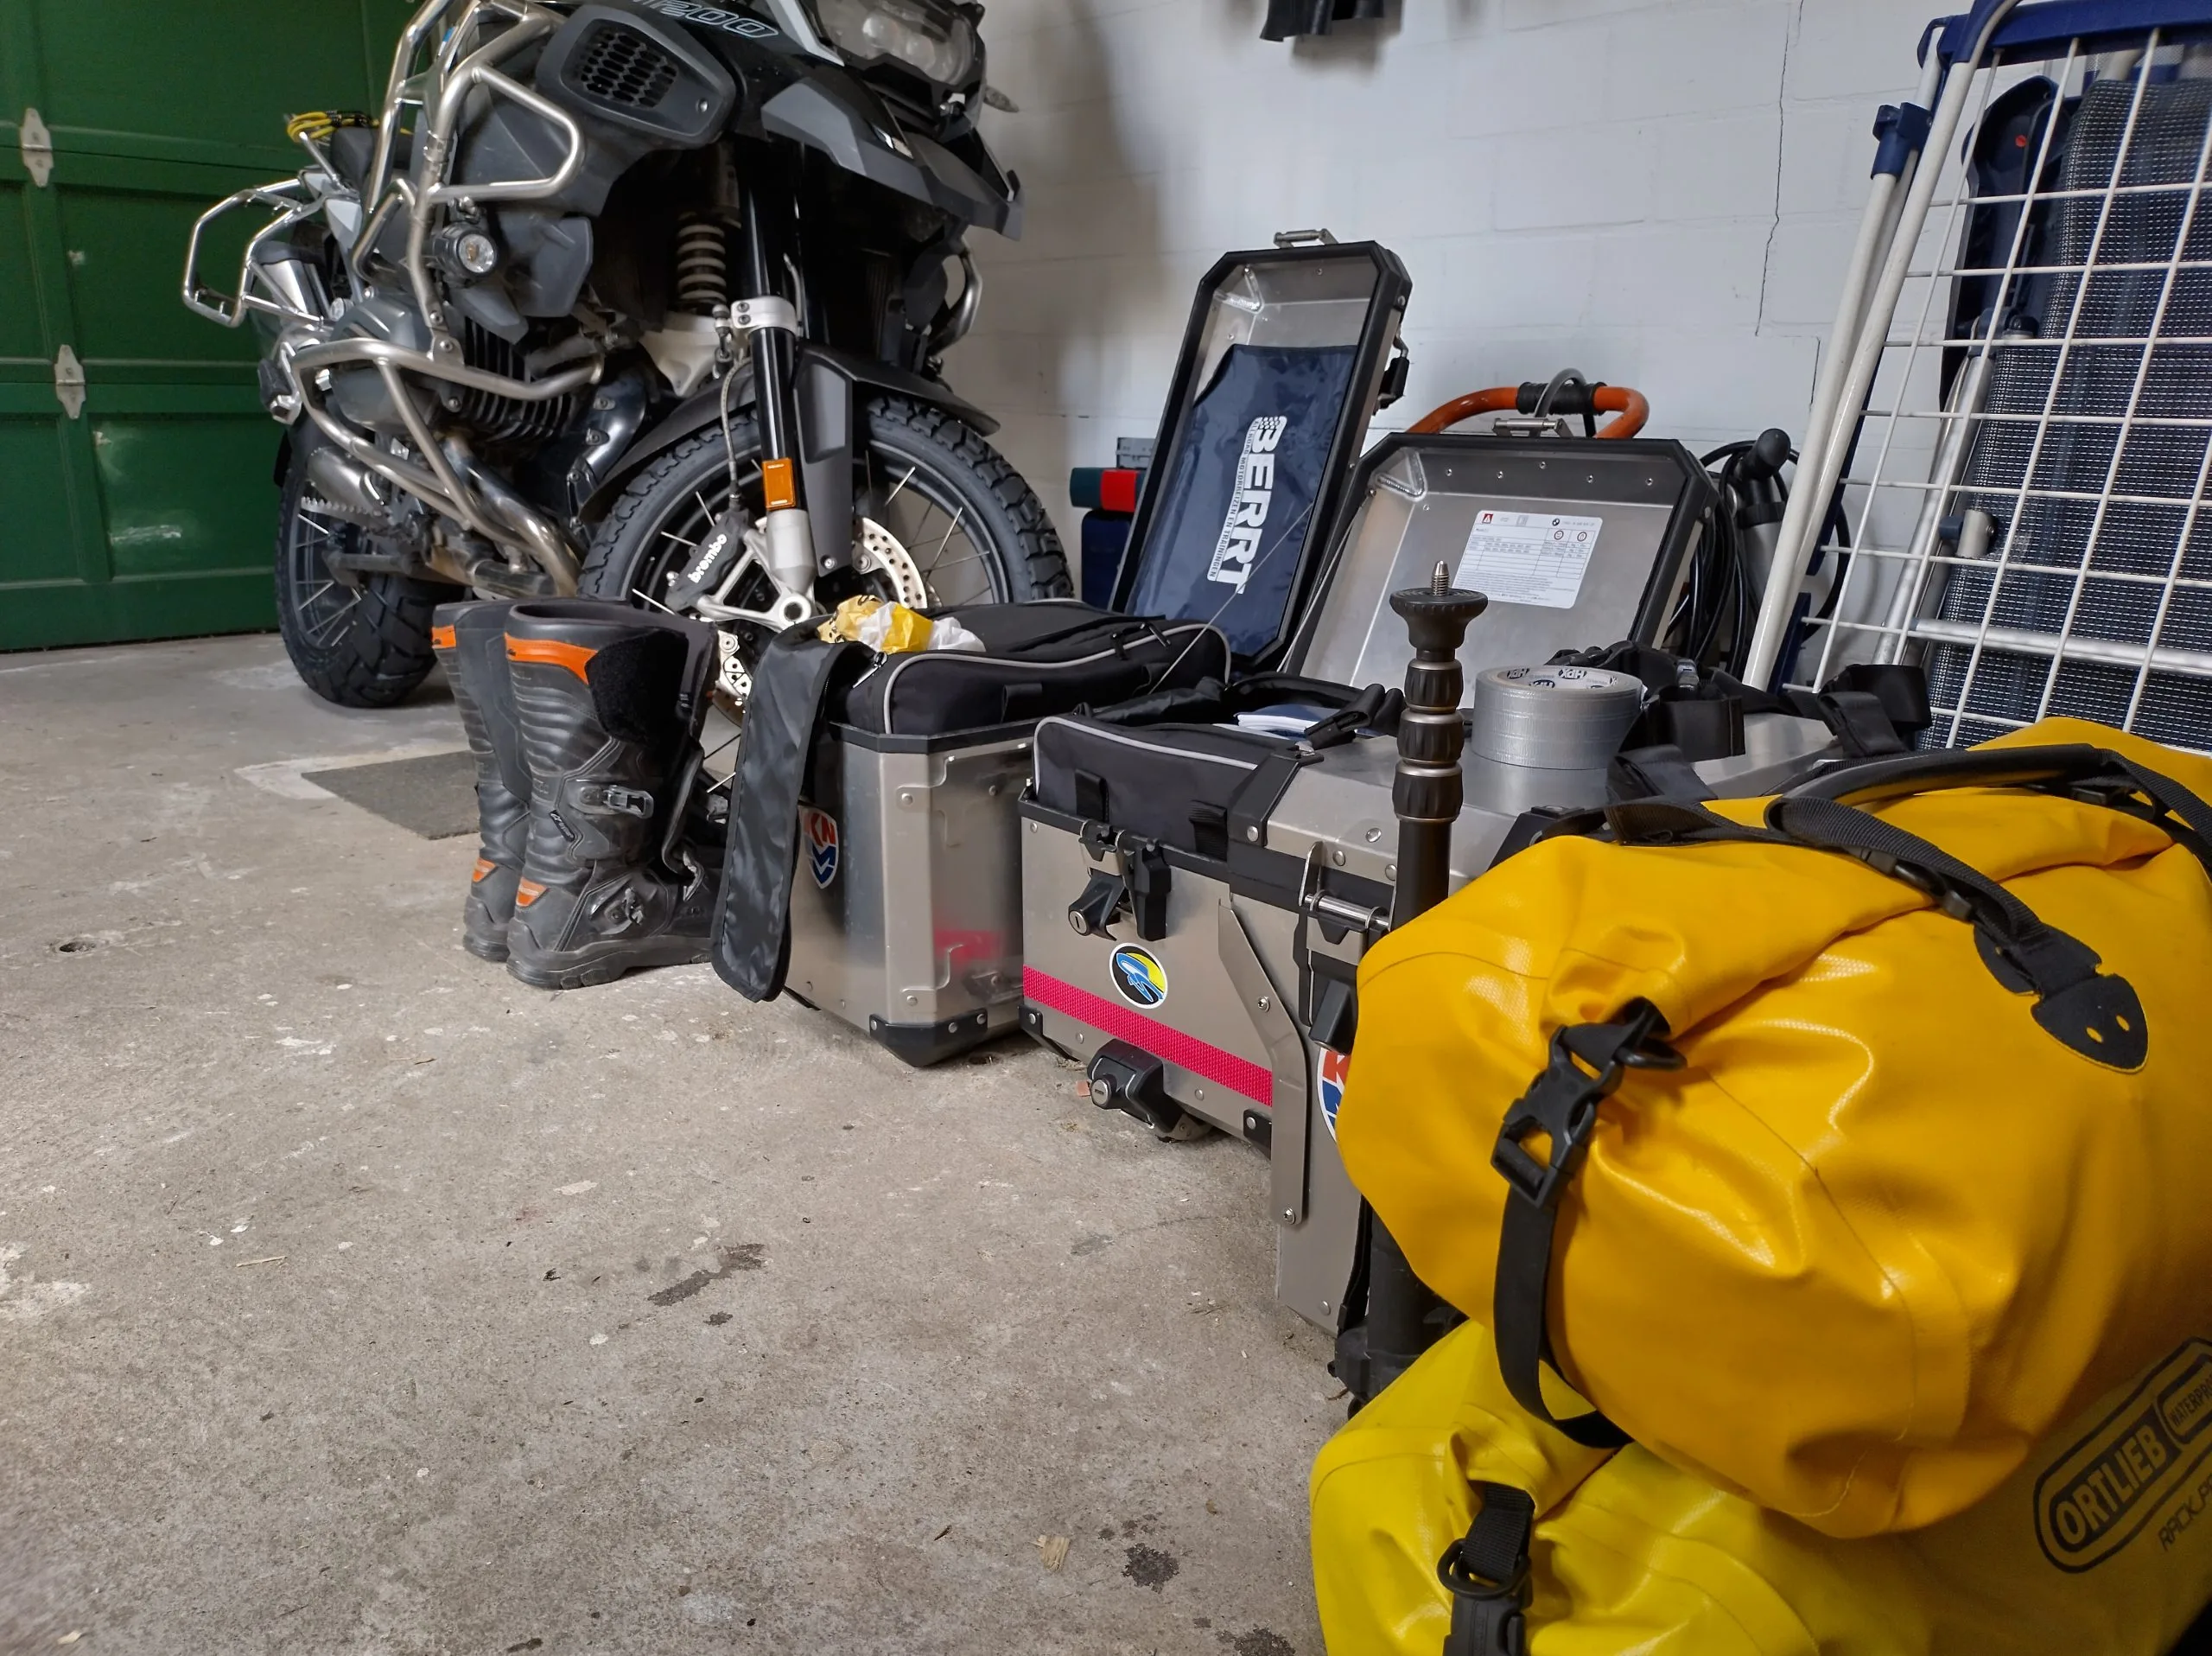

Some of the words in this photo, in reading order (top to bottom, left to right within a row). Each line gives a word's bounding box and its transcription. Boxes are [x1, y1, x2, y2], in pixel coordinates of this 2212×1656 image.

[1210, 530, 1231, 578] TRAININGEN
[1216, 416, 1287, 595] BERRT
[2056, 1424, 2167, 1545] ORTLIEB
